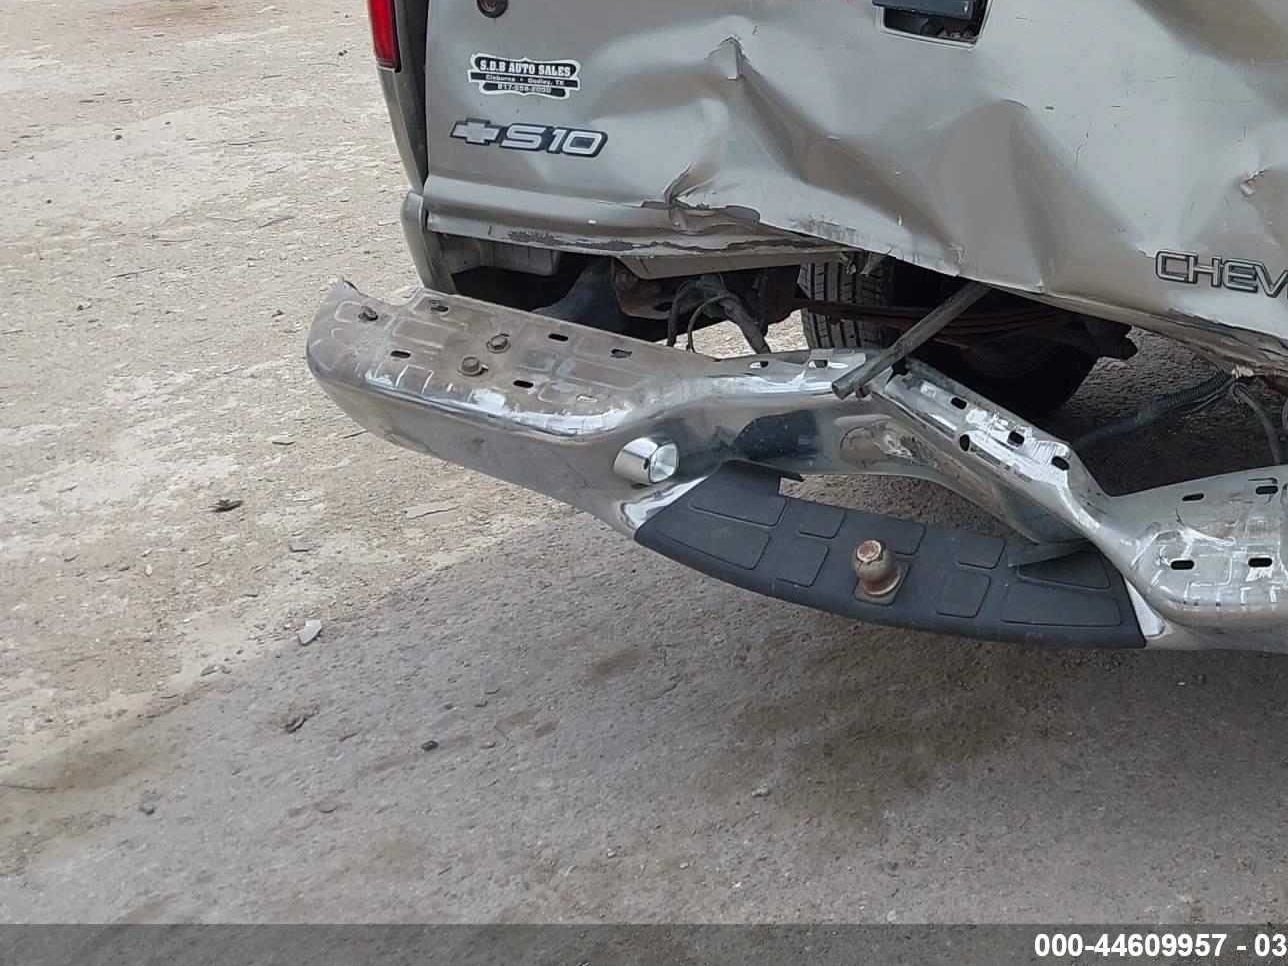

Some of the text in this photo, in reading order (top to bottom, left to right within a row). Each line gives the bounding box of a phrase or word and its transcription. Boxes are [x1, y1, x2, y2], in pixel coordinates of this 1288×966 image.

[480, 60, 571, 77] S.D.B AUTO SALES
[500, 123, 606, 156] S10
